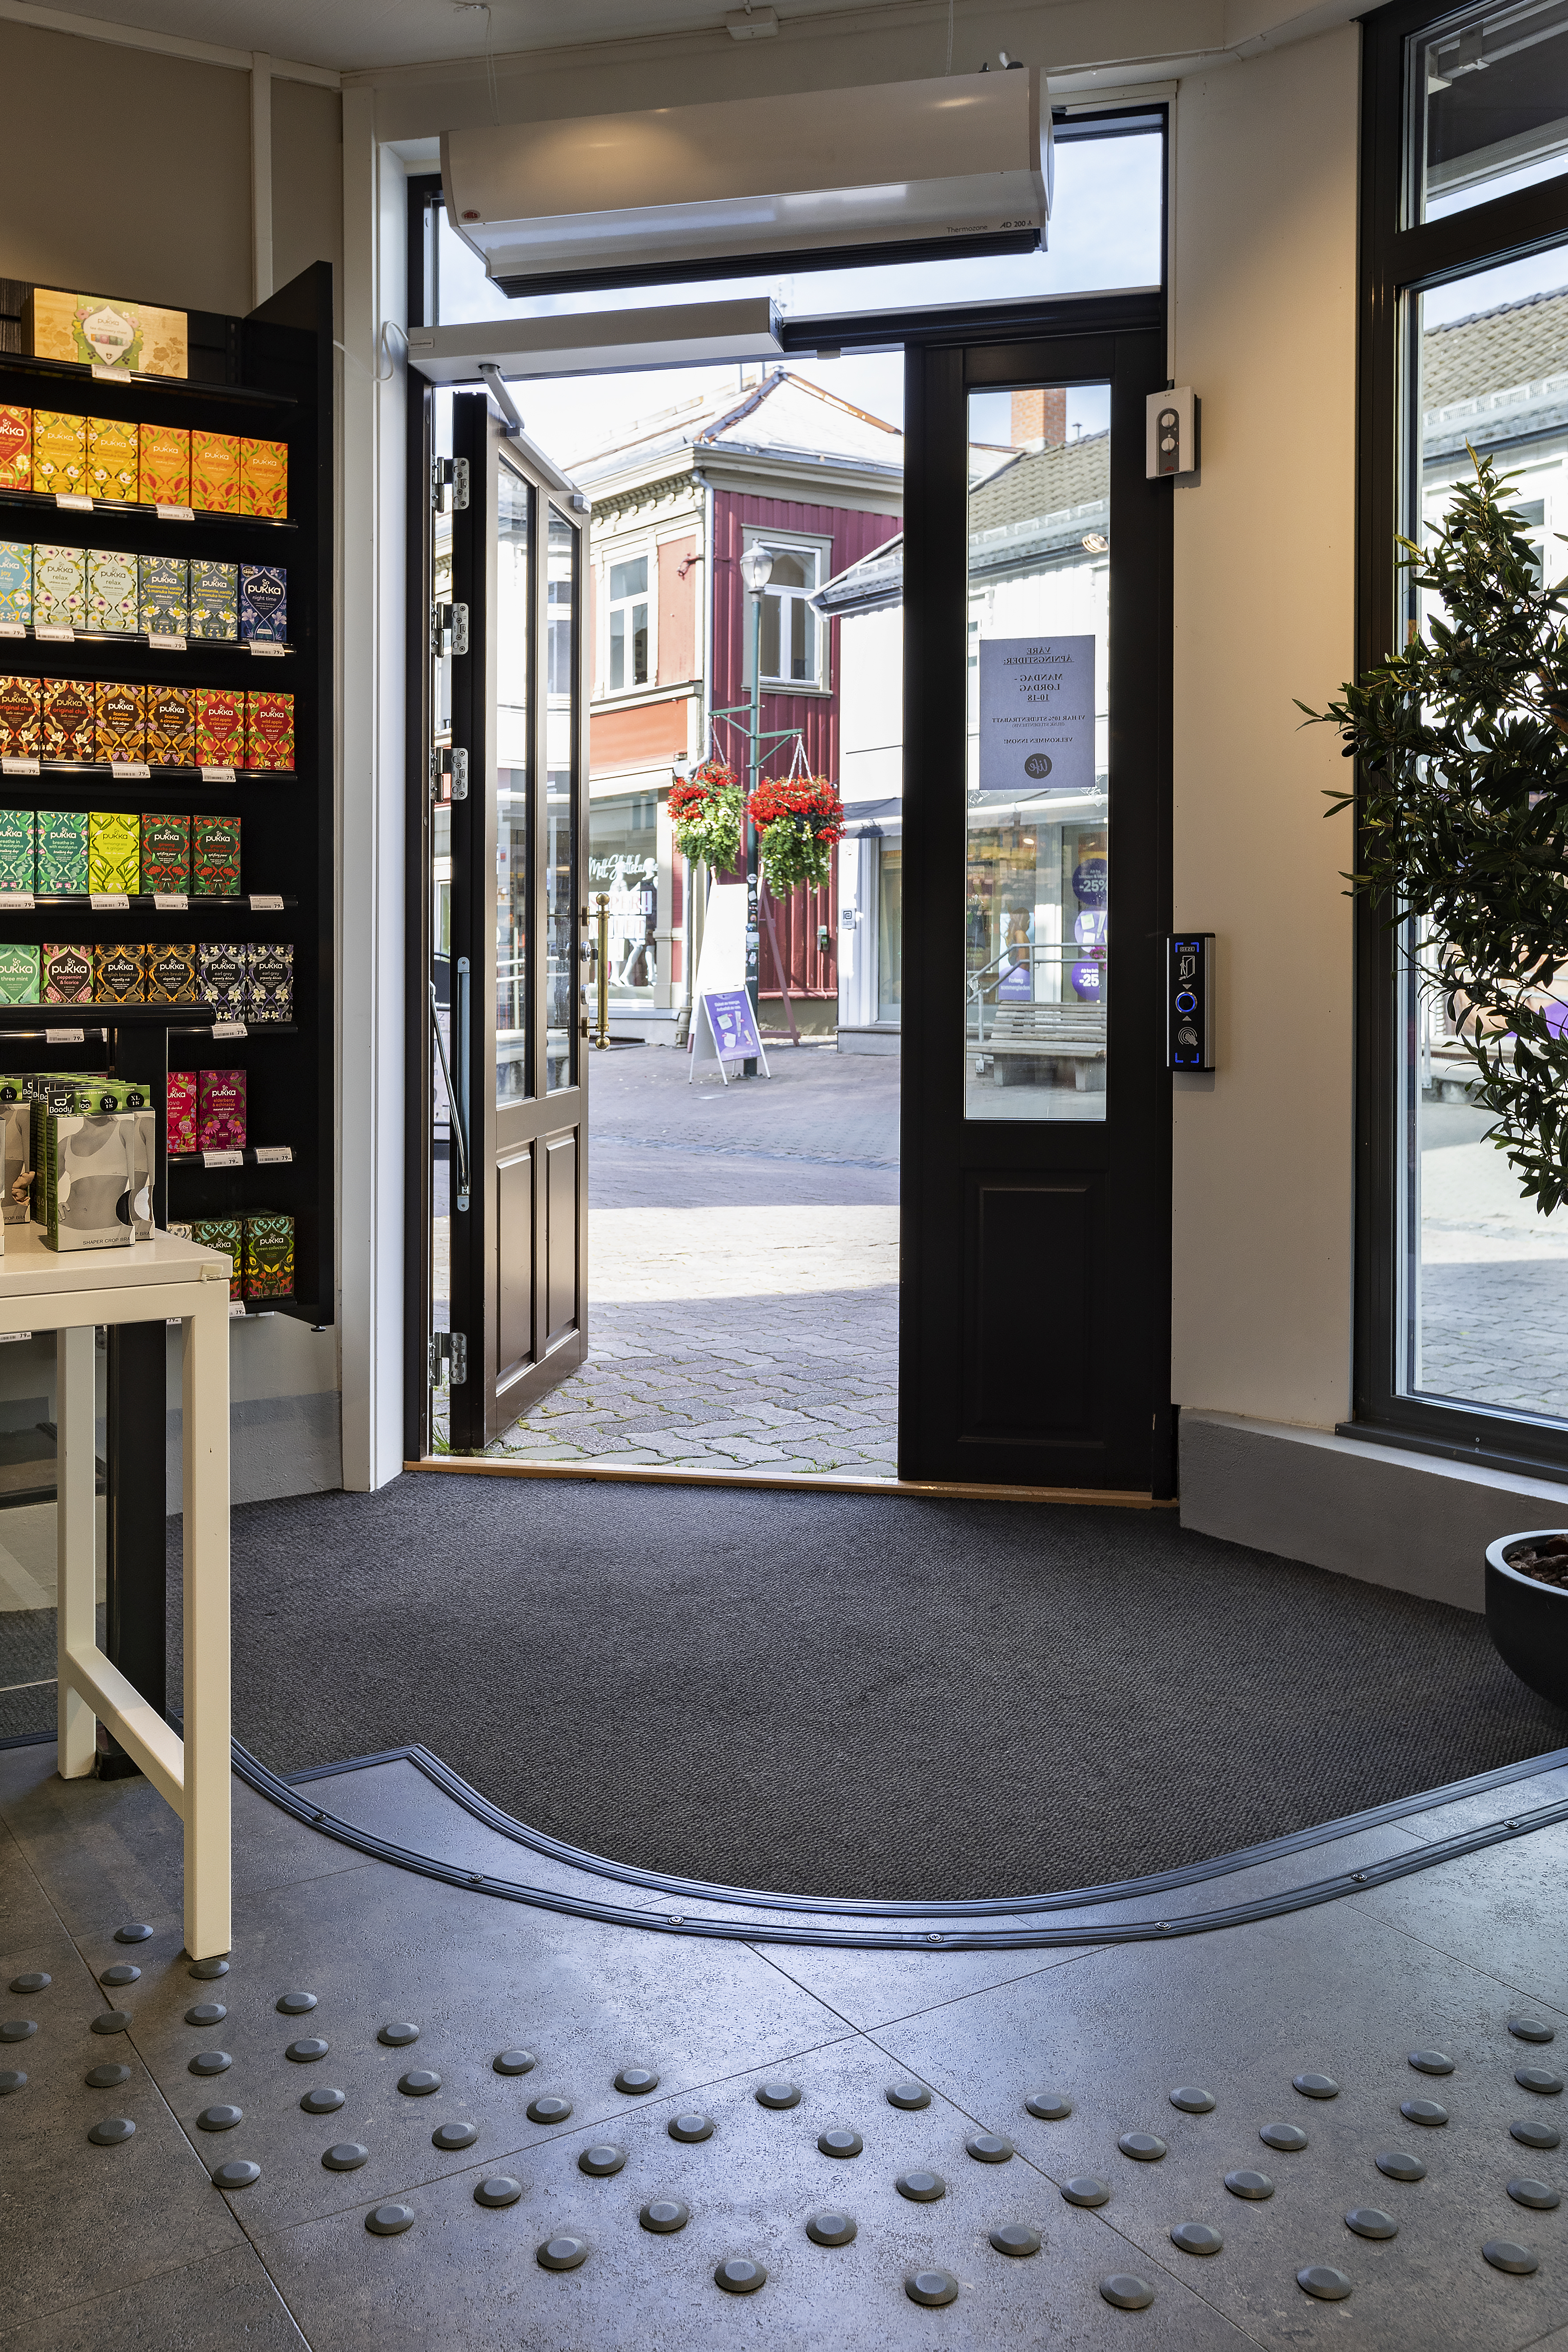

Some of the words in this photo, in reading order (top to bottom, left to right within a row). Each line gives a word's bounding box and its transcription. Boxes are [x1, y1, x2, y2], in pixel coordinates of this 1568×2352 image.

[947, 225, 988, 233] Thermozone
[48, 431, 73, 441] pukka
[101, 438, 126, 447] pukka
[153, 444, 178, 454] pukka
[205, 450, 229, 460] pukka
[253, 456, 276, 466] pukka
[48, 564, 73, 573] pukka
[101, 569, 126, 578] pukka
[152, 574, 177, 584] pukka
[202, 578, 227, 588] pukka
[248, 582, 281, 595] pukka
[2, 694, 28, 704] pukka
[56, 697, 82, 707] pukka
[108, 701, 134, 711] pukka
[160, 703, 184, 714] pukka
[208, 707, 233, 716] pukka
[260, 709, 284, 719] pukka
[50, 830, 76, 839] pukka
[103, 831, 128, 840] pukka
[154, 831, 179, 841] pukka
[206, 833, 230, 843] pukka
[52, 962, 87, 975] pukka
[108, 961, 133, 971] pukka
[160, 961, 184, 971] pukka
[211, 961, 235, 970] pukka
[259, 961, 283, 970] pukka
[212, 1088, 235, 1097] pukka
[49, 1106, 72, 1114] Boody
[260, 1235, 283, 1246] pukka
